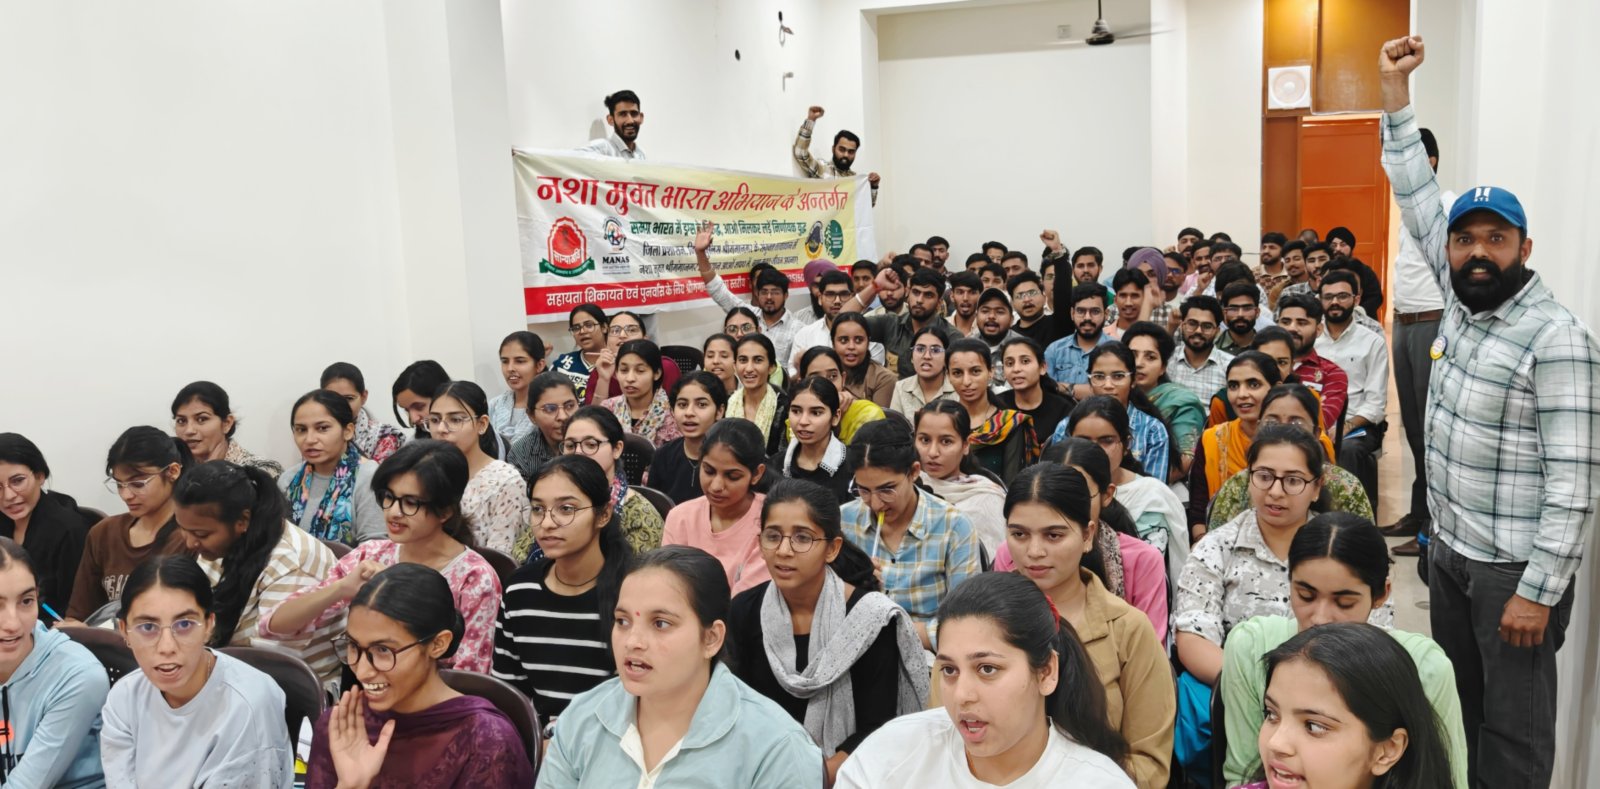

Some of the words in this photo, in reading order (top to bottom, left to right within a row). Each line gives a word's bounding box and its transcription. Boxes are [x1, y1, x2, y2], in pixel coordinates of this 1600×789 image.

[537, 176, 599, 206] नशा
[661, 186, 716, 210] भारत
[713, 182, 783, 211] अभियान
[797, 184, 848, 211] अन्तर्गत
[652, 222, 674, 235] भारत
[602, 256, 630, 265] MANAS
[546, 292, 582, 307] सहायता
[585, 286, 623, 303] शिकायत
[626, 285, 638, 299] एवं
